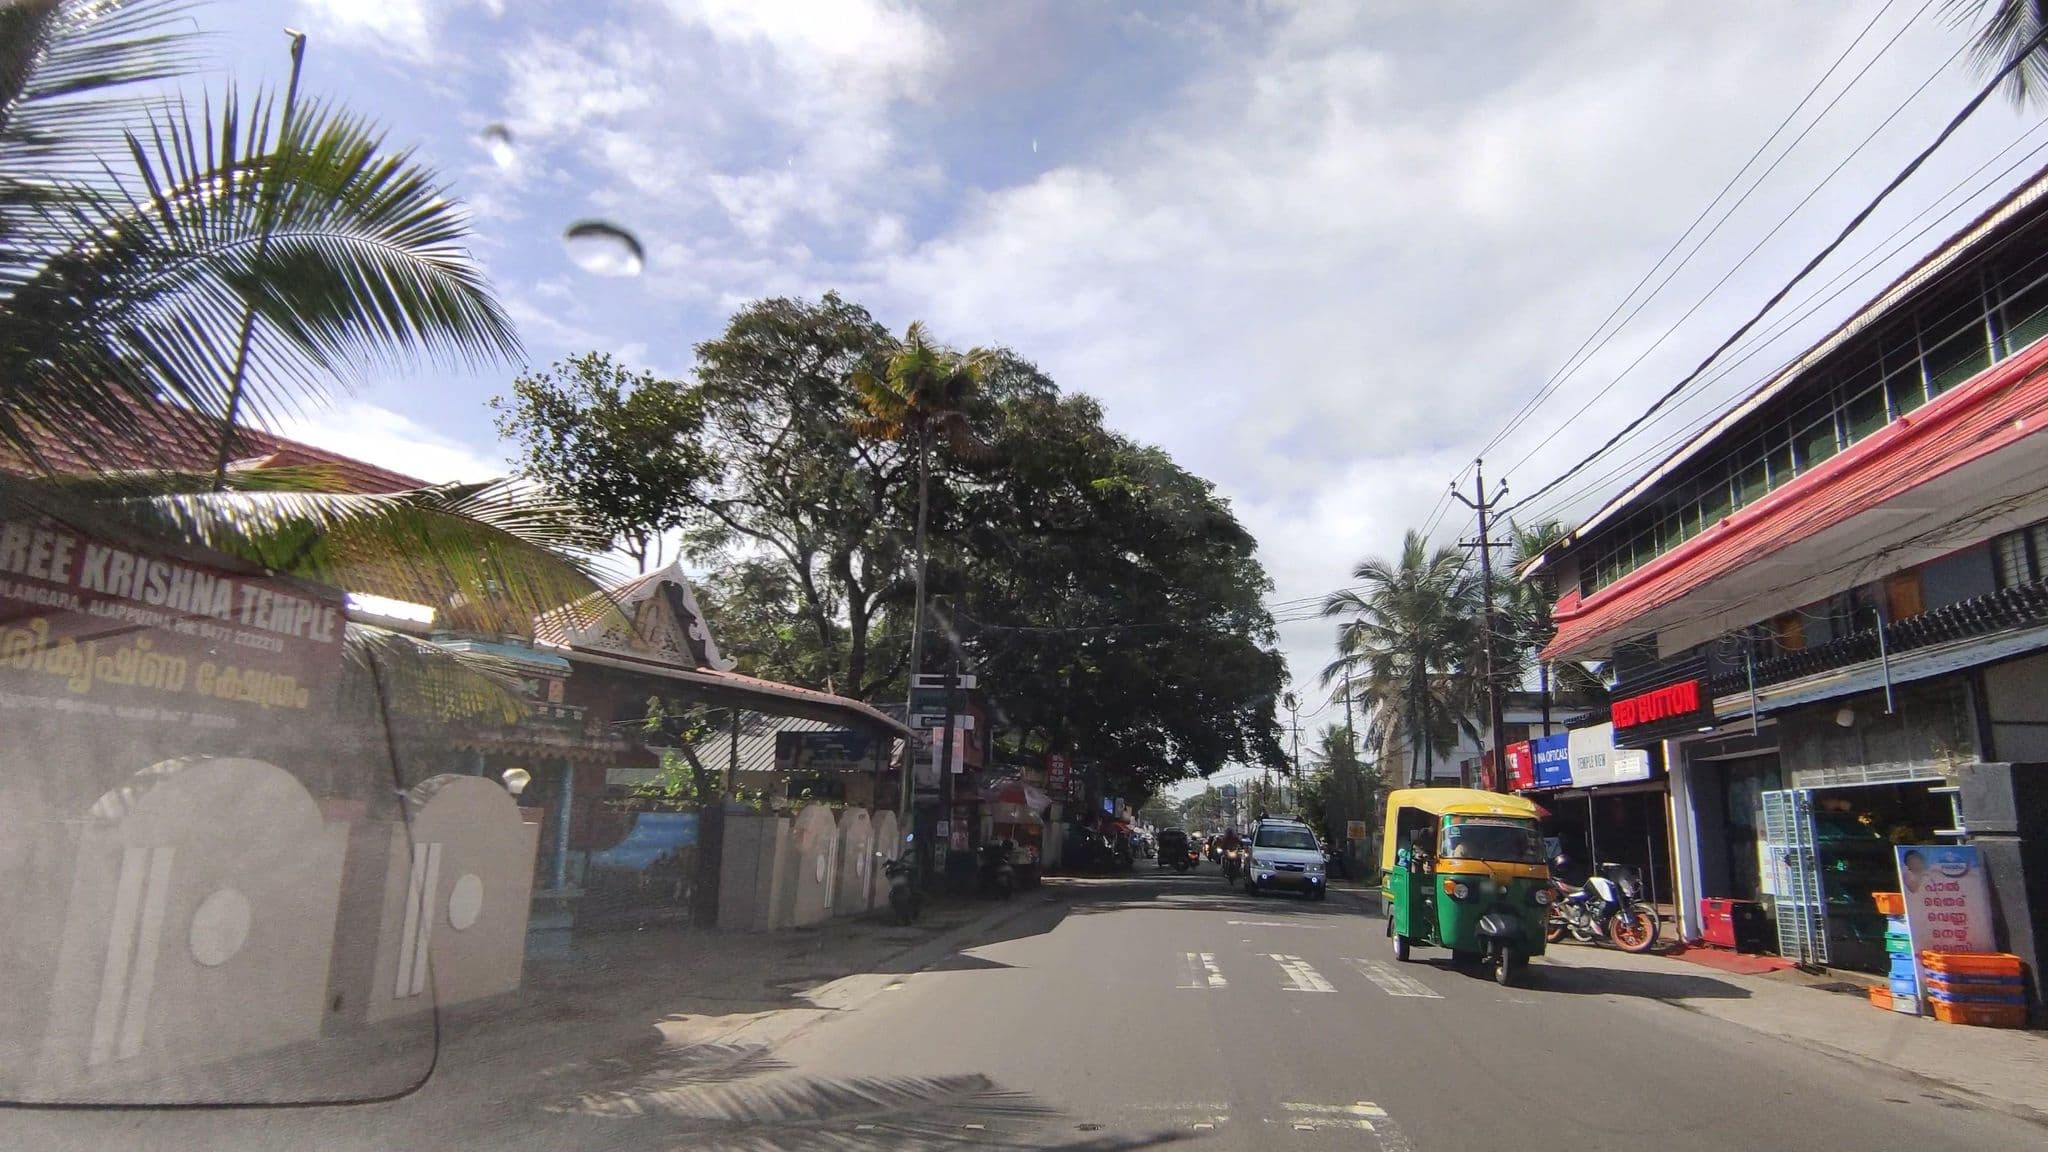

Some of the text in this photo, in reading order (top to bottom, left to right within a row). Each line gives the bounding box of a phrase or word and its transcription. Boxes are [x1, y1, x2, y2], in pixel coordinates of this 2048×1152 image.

[80, 543, 234, 621] KRISHNA
[239, 582, 337, 643] TEMPLE
[1612, 681, 1698, 728] RED BUTTON
[1546, 748, 1568, 762] OPTICALS
